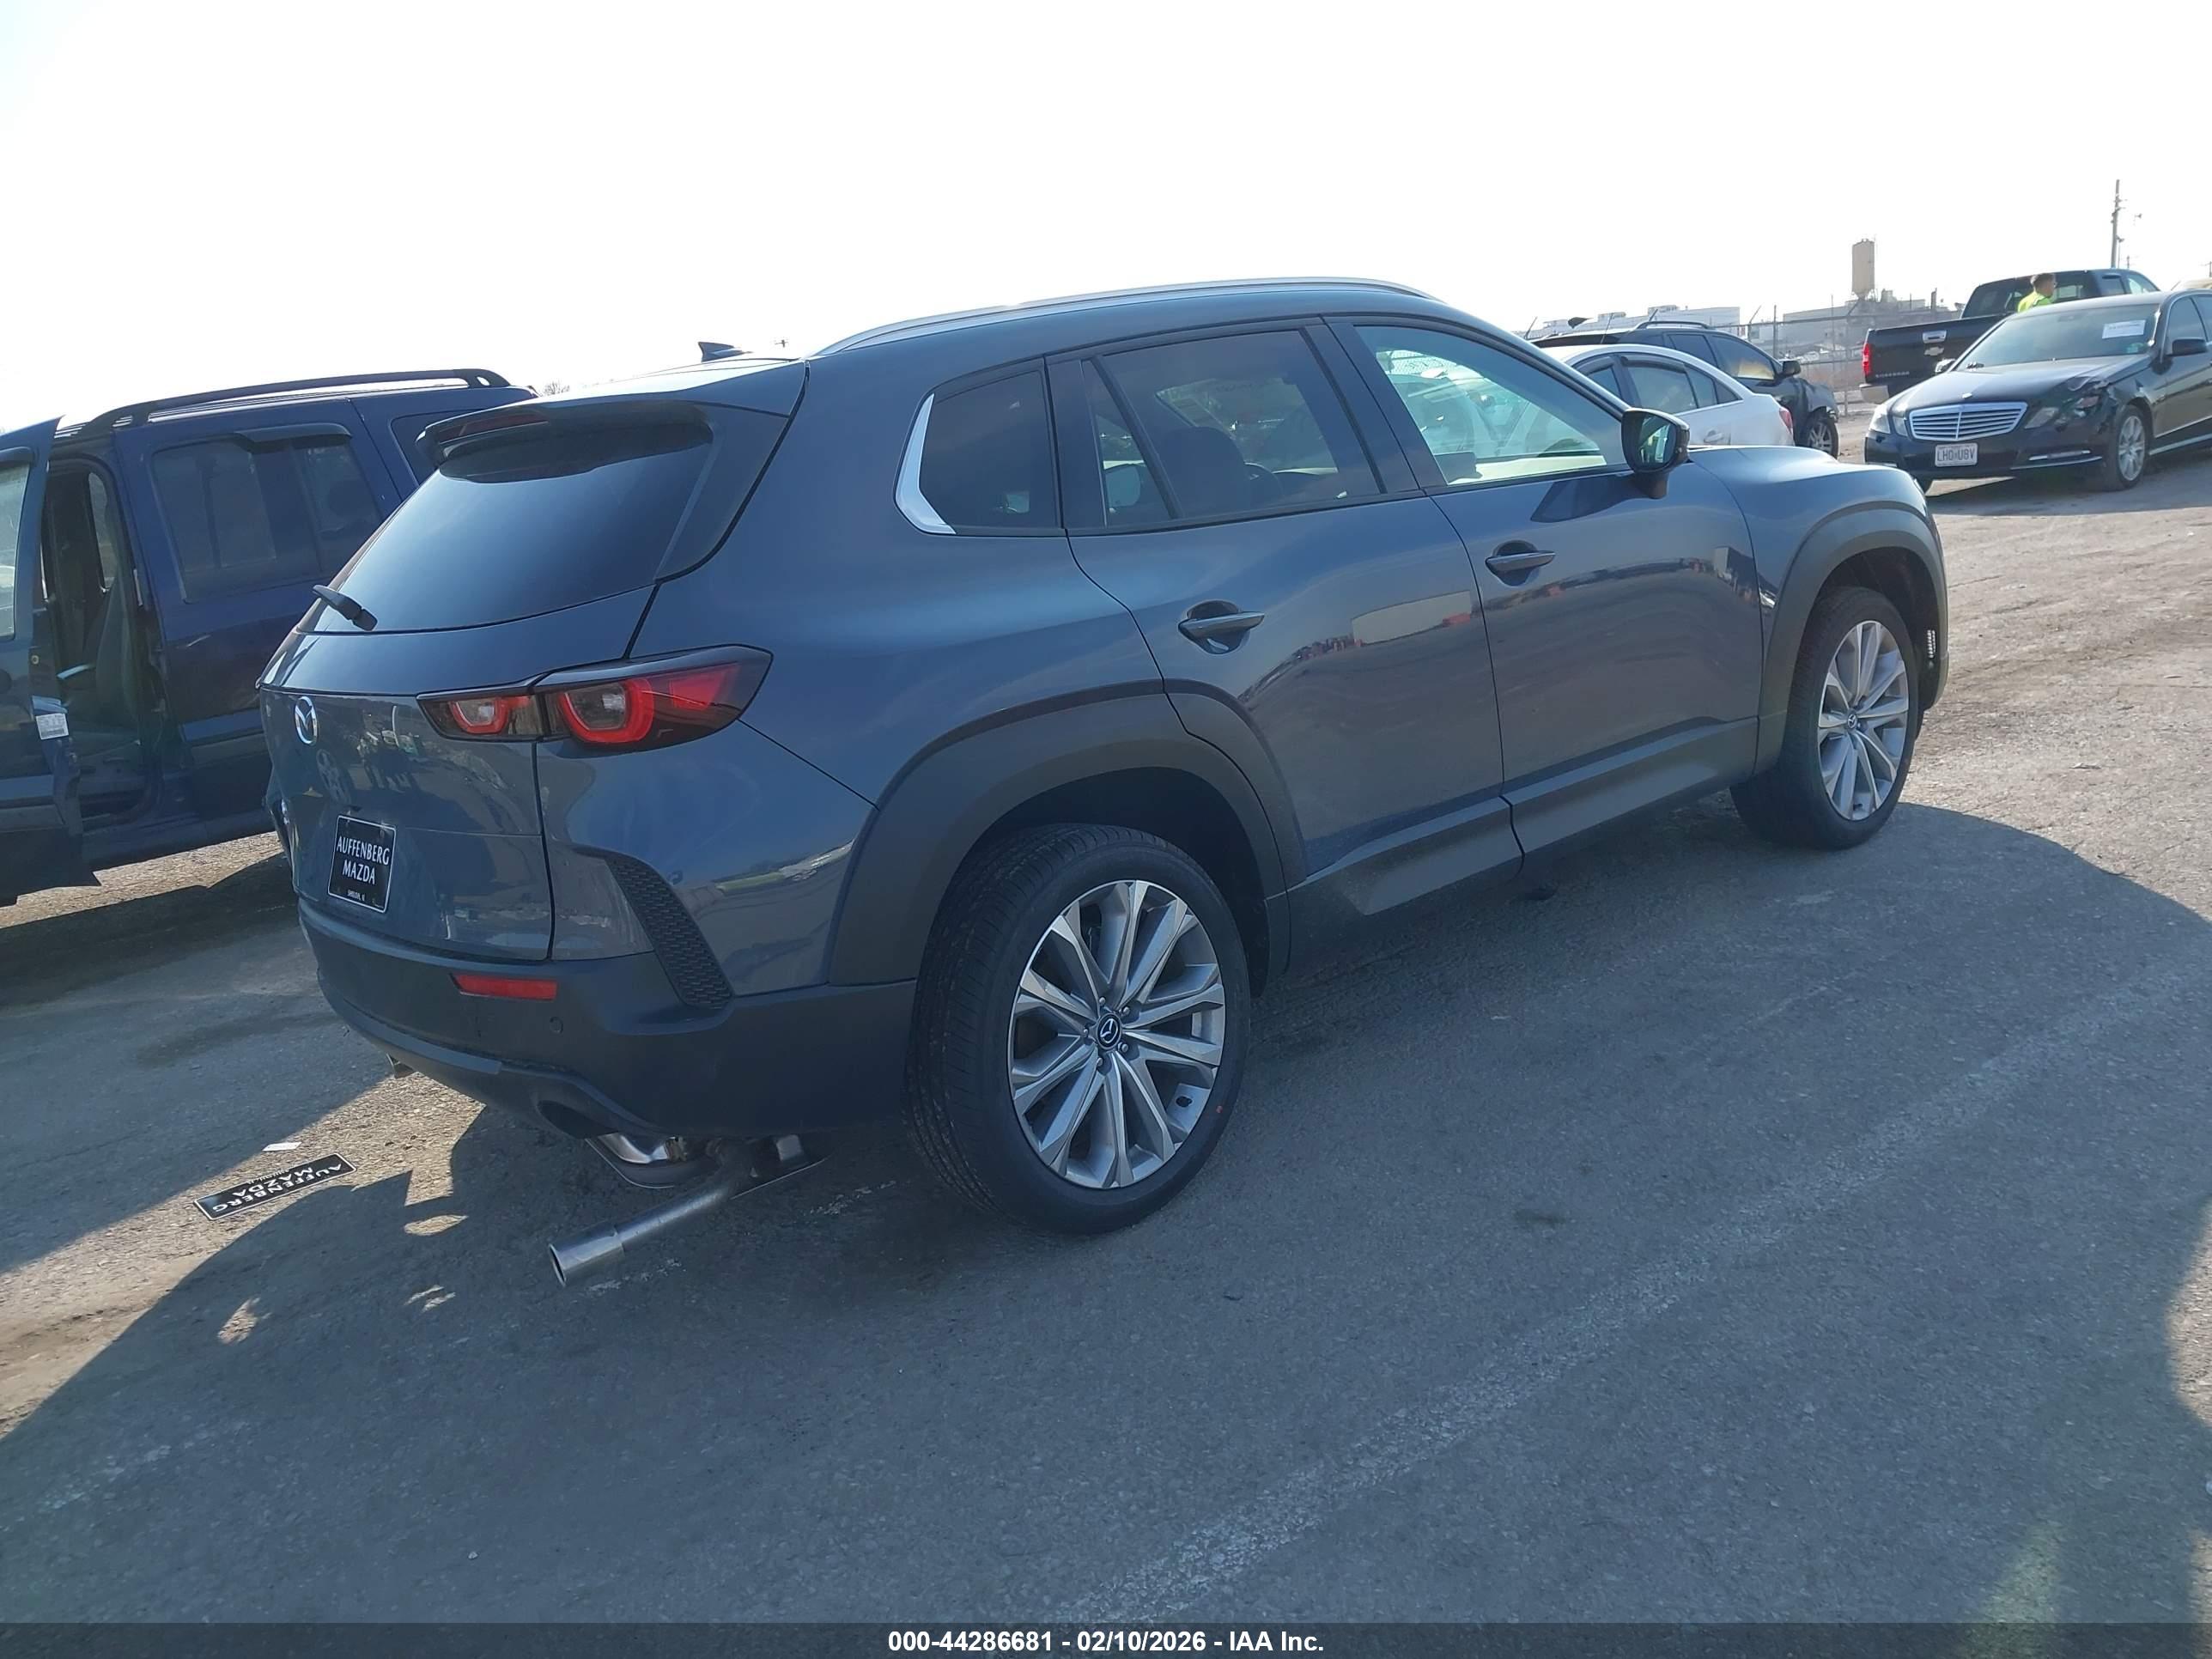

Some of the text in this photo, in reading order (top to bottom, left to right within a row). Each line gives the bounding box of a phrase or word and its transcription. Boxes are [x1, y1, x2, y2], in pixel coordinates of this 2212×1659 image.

[337, 836, 390, 866] AUFFENBERG
[343, 860, 375, 884] MAZDA
[212, 1163, 342, 1212] AUFFENBERG
[233, 1167, 313, 1196] MAZDA
